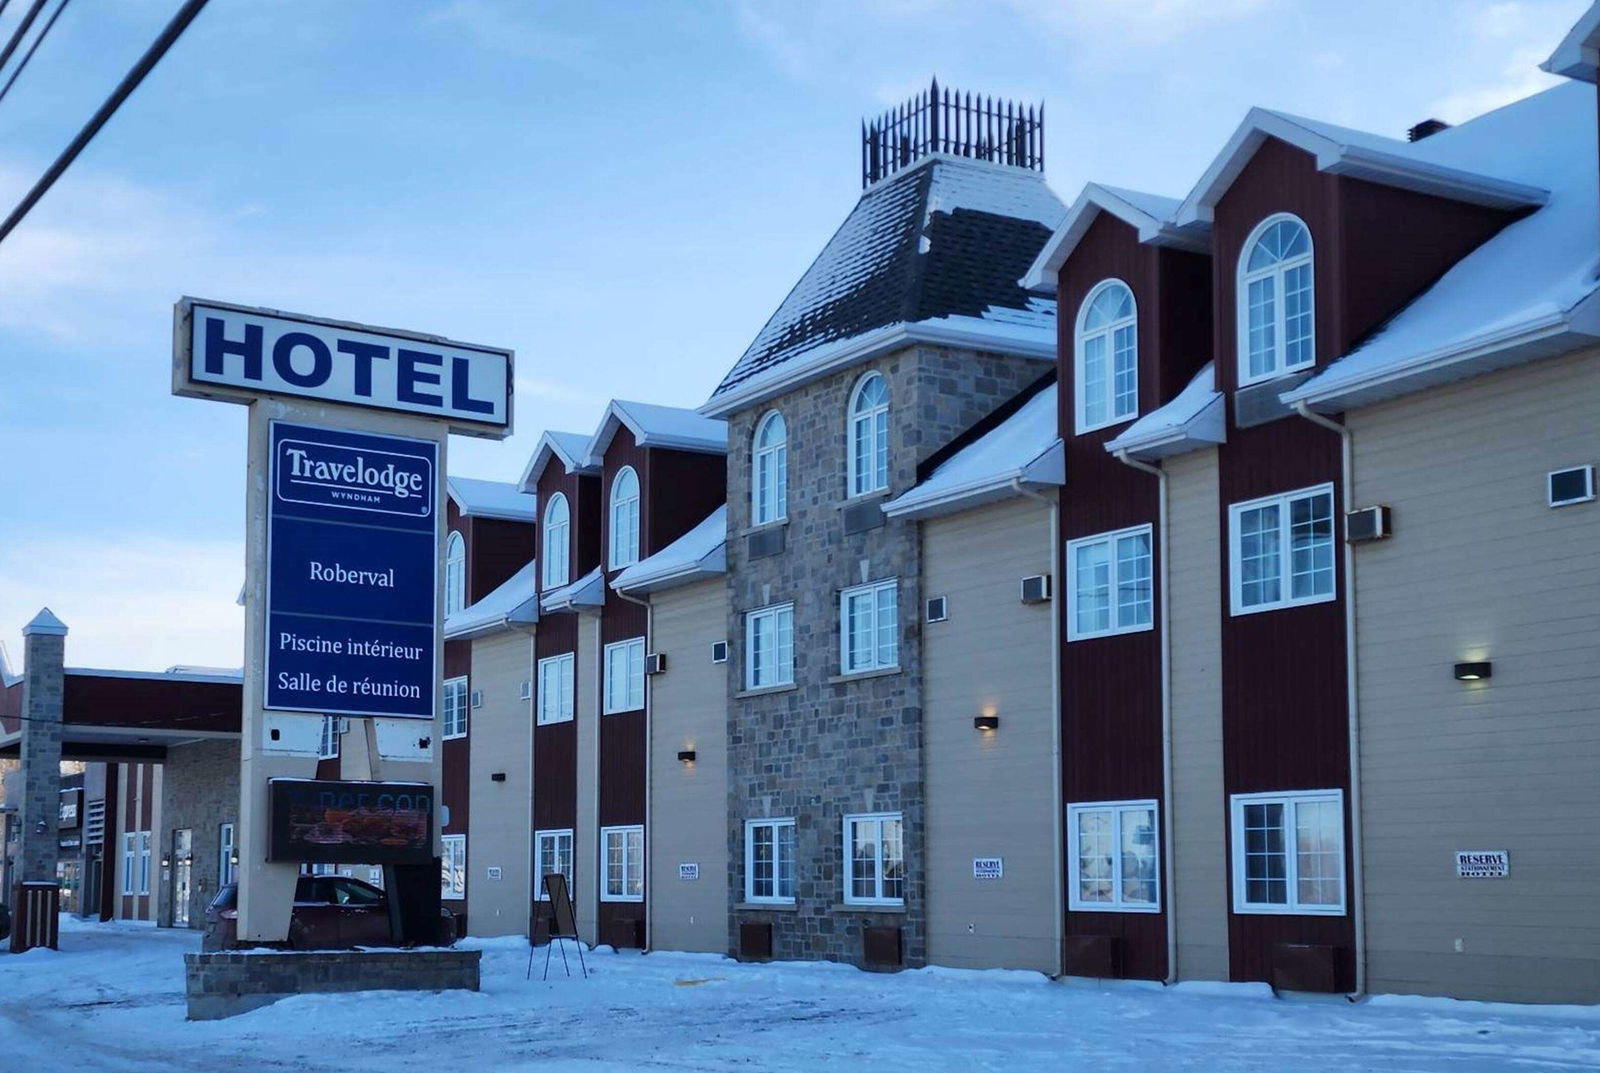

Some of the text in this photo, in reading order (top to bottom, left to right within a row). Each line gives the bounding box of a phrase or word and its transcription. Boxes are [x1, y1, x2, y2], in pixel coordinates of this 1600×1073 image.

[205, 317, 495, 415] HOTEL
[286, 448, 423, 498] Travelodge
[331, 491, 381, 503] WYNDHAM
[310, 561, 394, 588] Roberval
[280, 632, 424, 660] Piscine intérieur
[278, 672, 421, 699] Salle de réunion
